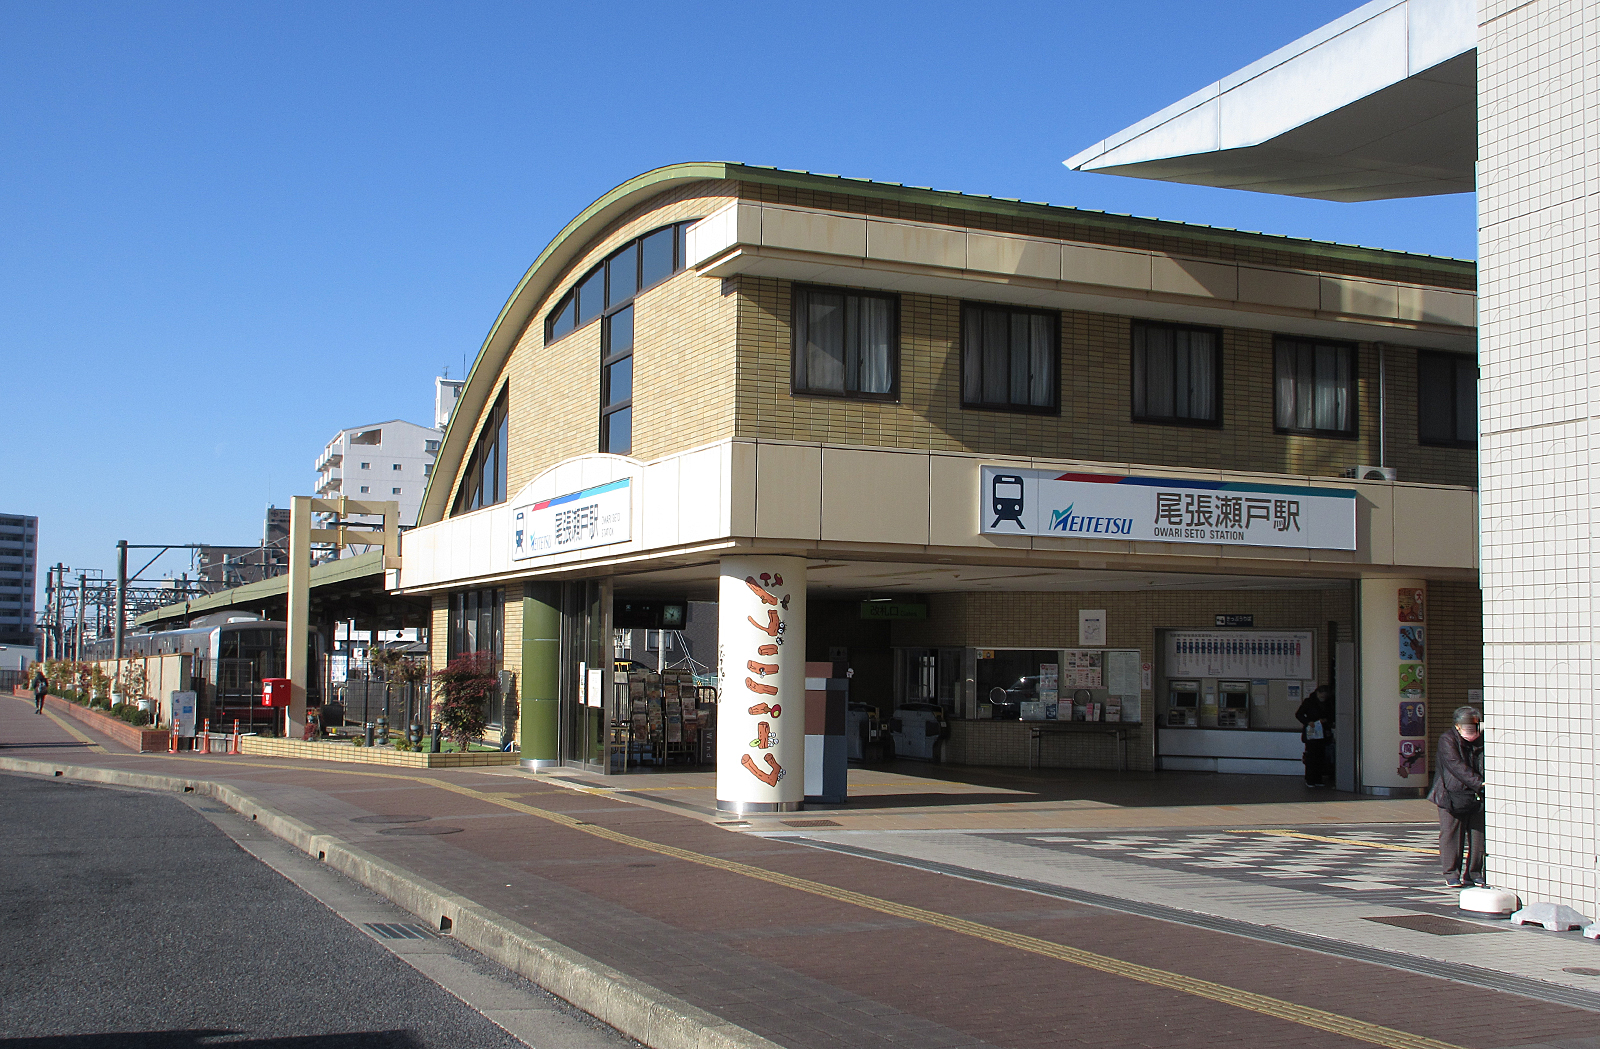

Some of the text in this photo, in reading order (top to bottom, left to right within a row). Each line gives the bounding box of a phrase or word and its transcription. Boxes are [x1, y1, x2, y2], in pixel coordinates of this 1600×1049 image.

[555, 503, 599, 545] 尾張瀬戸駅
[1048, 501, 1133, 535] MEITETSU
[1154, 492, 1300, 532] 尾張瀬戸駅
[1154, 527, 1245, 541] OWARI SETO STATION
[870, 604, 899, 616] 改札口
